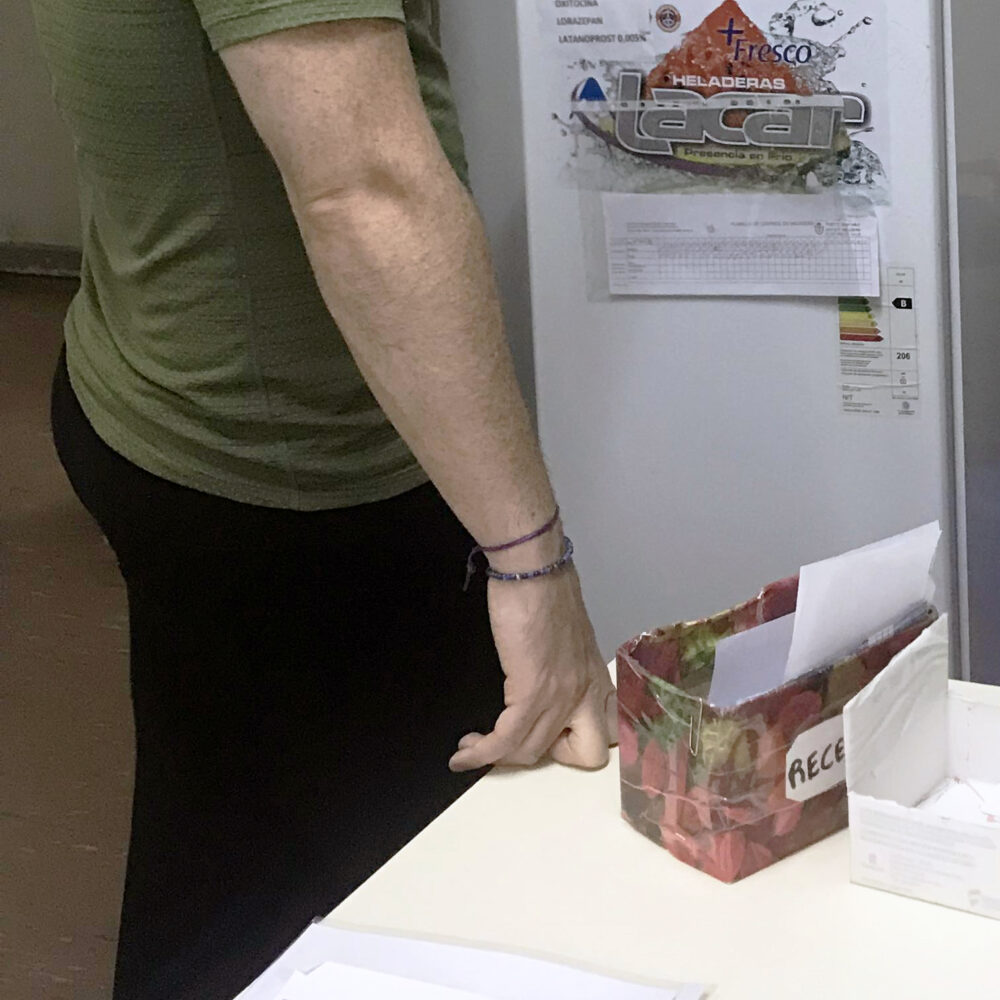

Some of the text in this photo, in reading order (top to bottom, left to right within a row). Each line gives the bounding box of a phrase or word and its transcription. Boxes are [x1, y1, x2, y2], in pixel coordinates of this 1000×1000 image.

[555, 0, 599, 8] OXITOCINA
[558, 34, 616, 44] LATANOPROST
[734, 39, 812, 64] Fresco
[672, 74, 786, 90] HELADERAS
[684, 147, 745, 159] Presencia
[896, 352, 911, 360] 206
